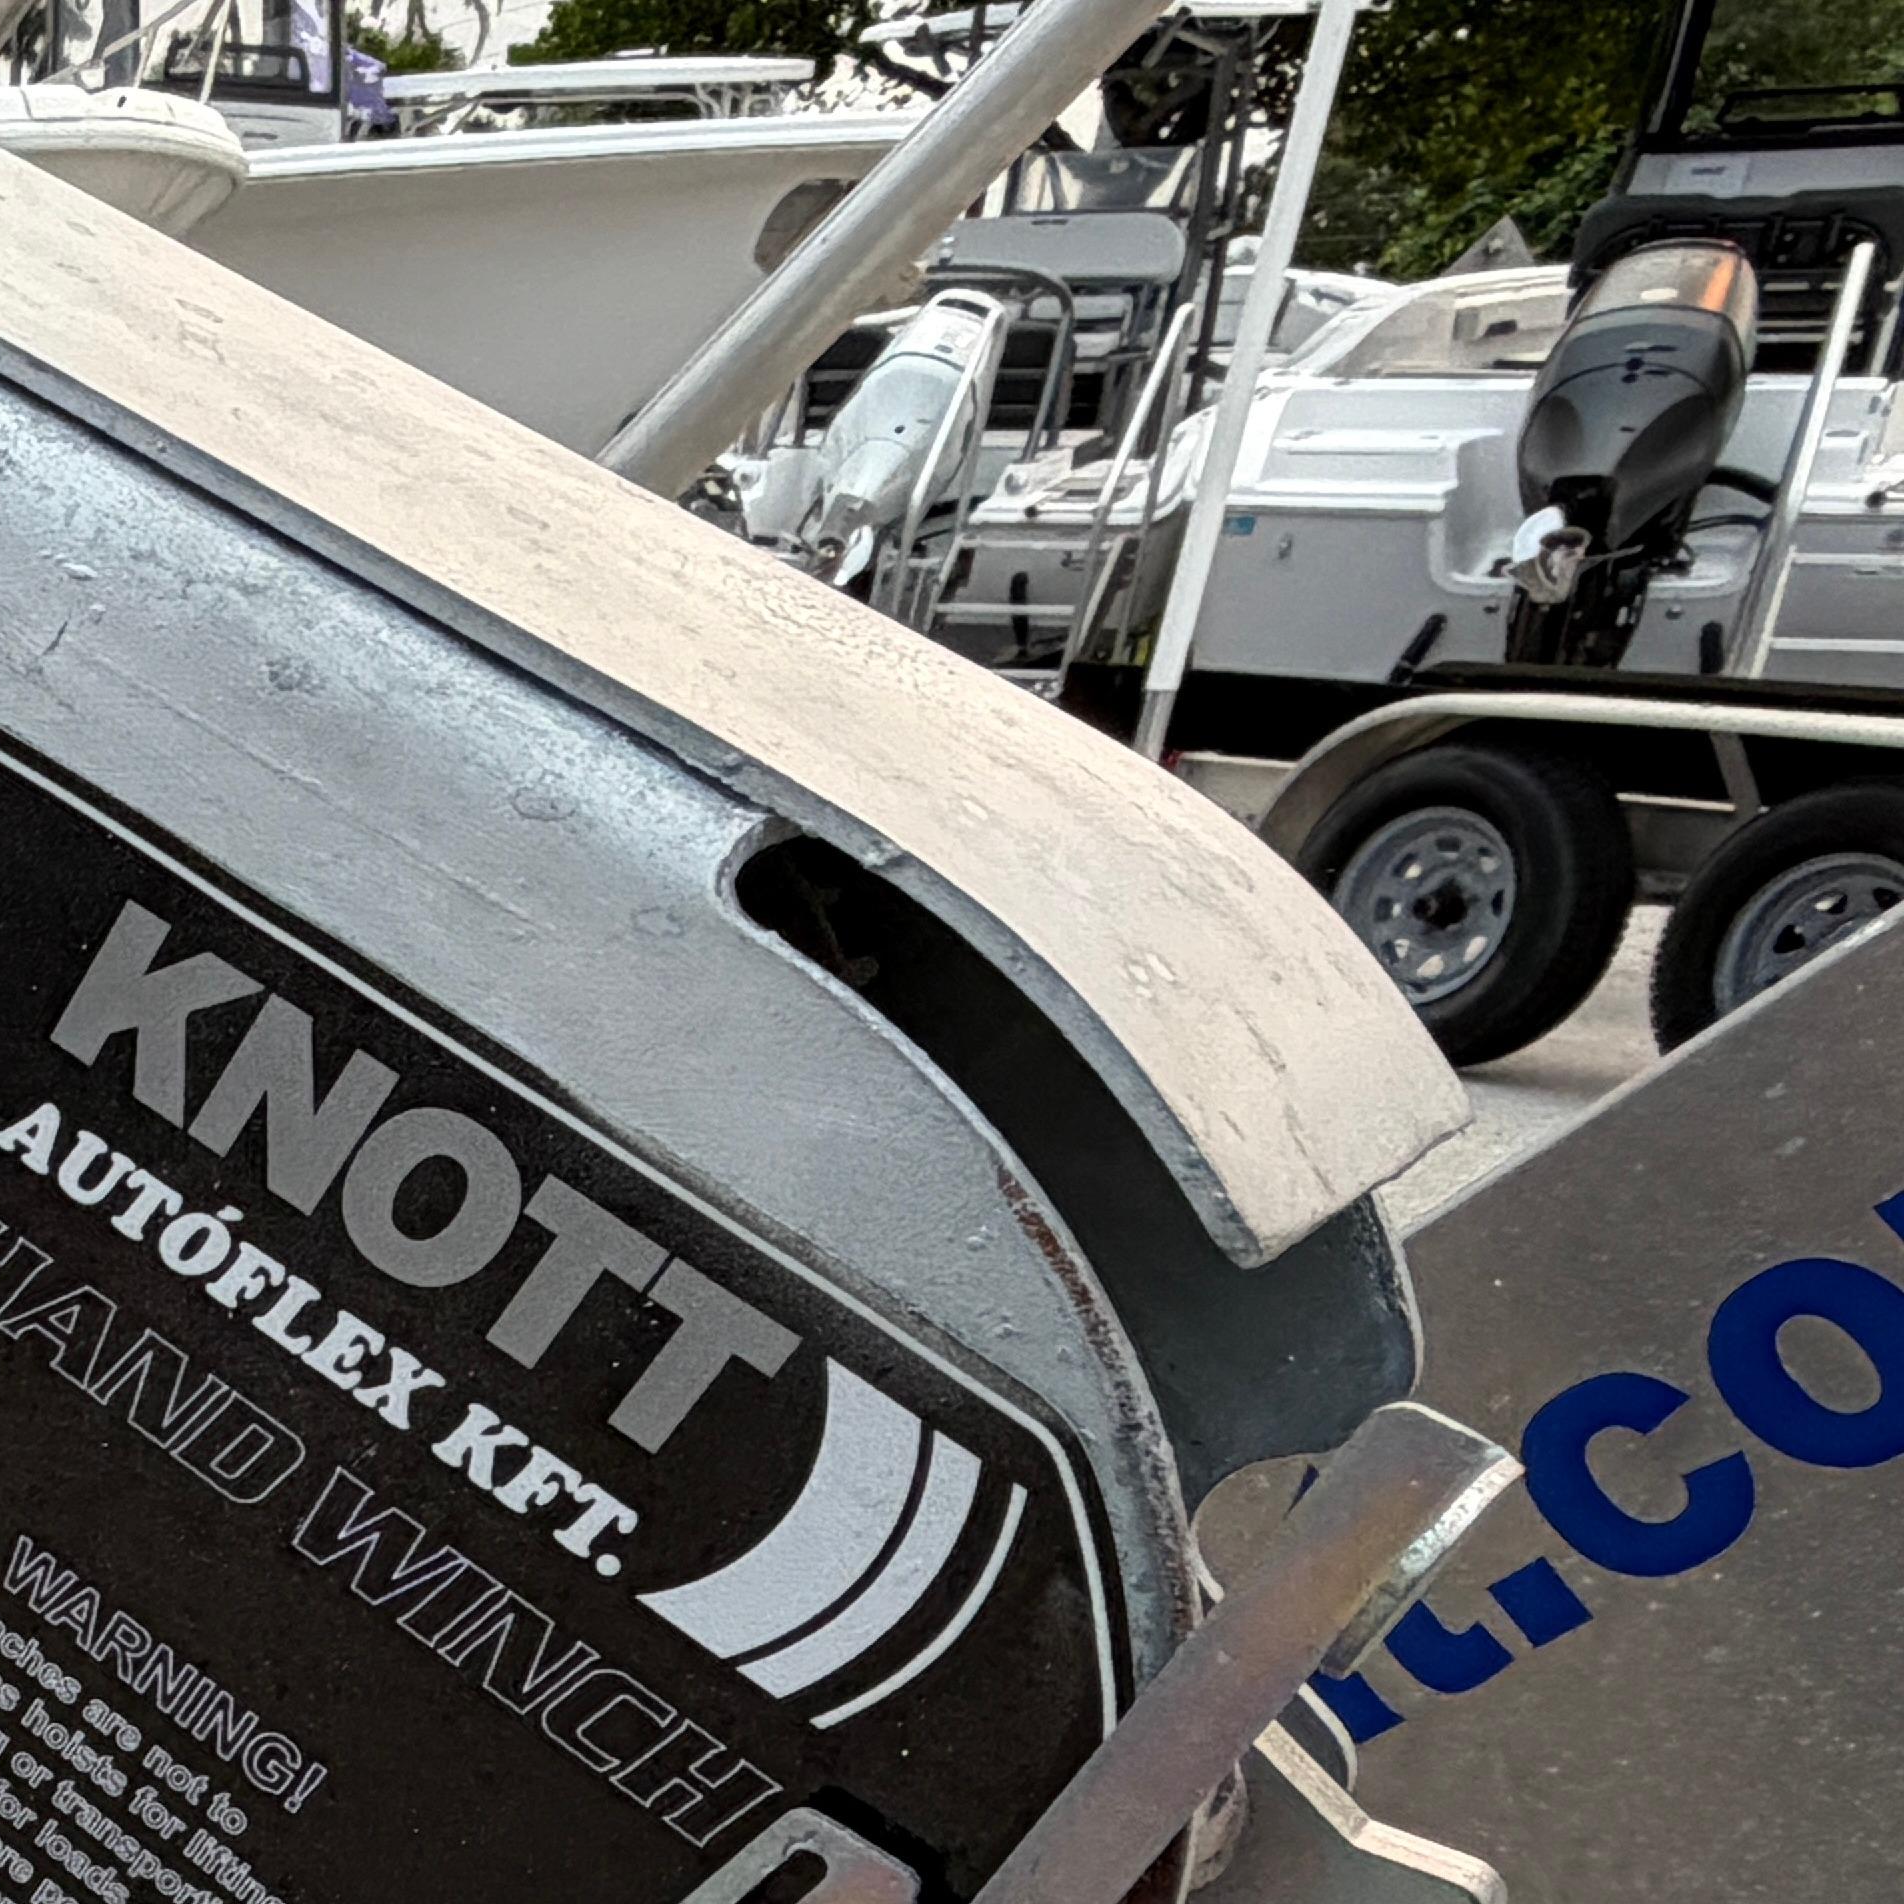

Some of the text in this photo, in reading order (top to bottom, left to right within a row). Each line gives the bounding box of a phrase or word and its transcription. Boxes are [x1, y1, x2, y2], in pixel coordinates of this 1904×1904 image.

[48, 900, 803, 1455] KNOTT
[430, 1400, 642, 1578] KFT.
[290, 1466, 783, 1849] WINCH
[10, 1751, 54, 1787] or
[20, 1698, 129, 1798] hoists
[128, 1785, 188, 1839] for
[82, 1698, 142, 1752] are
[143, 1743, 210, 1805] not
[206, 1791, 248, 1836] to
